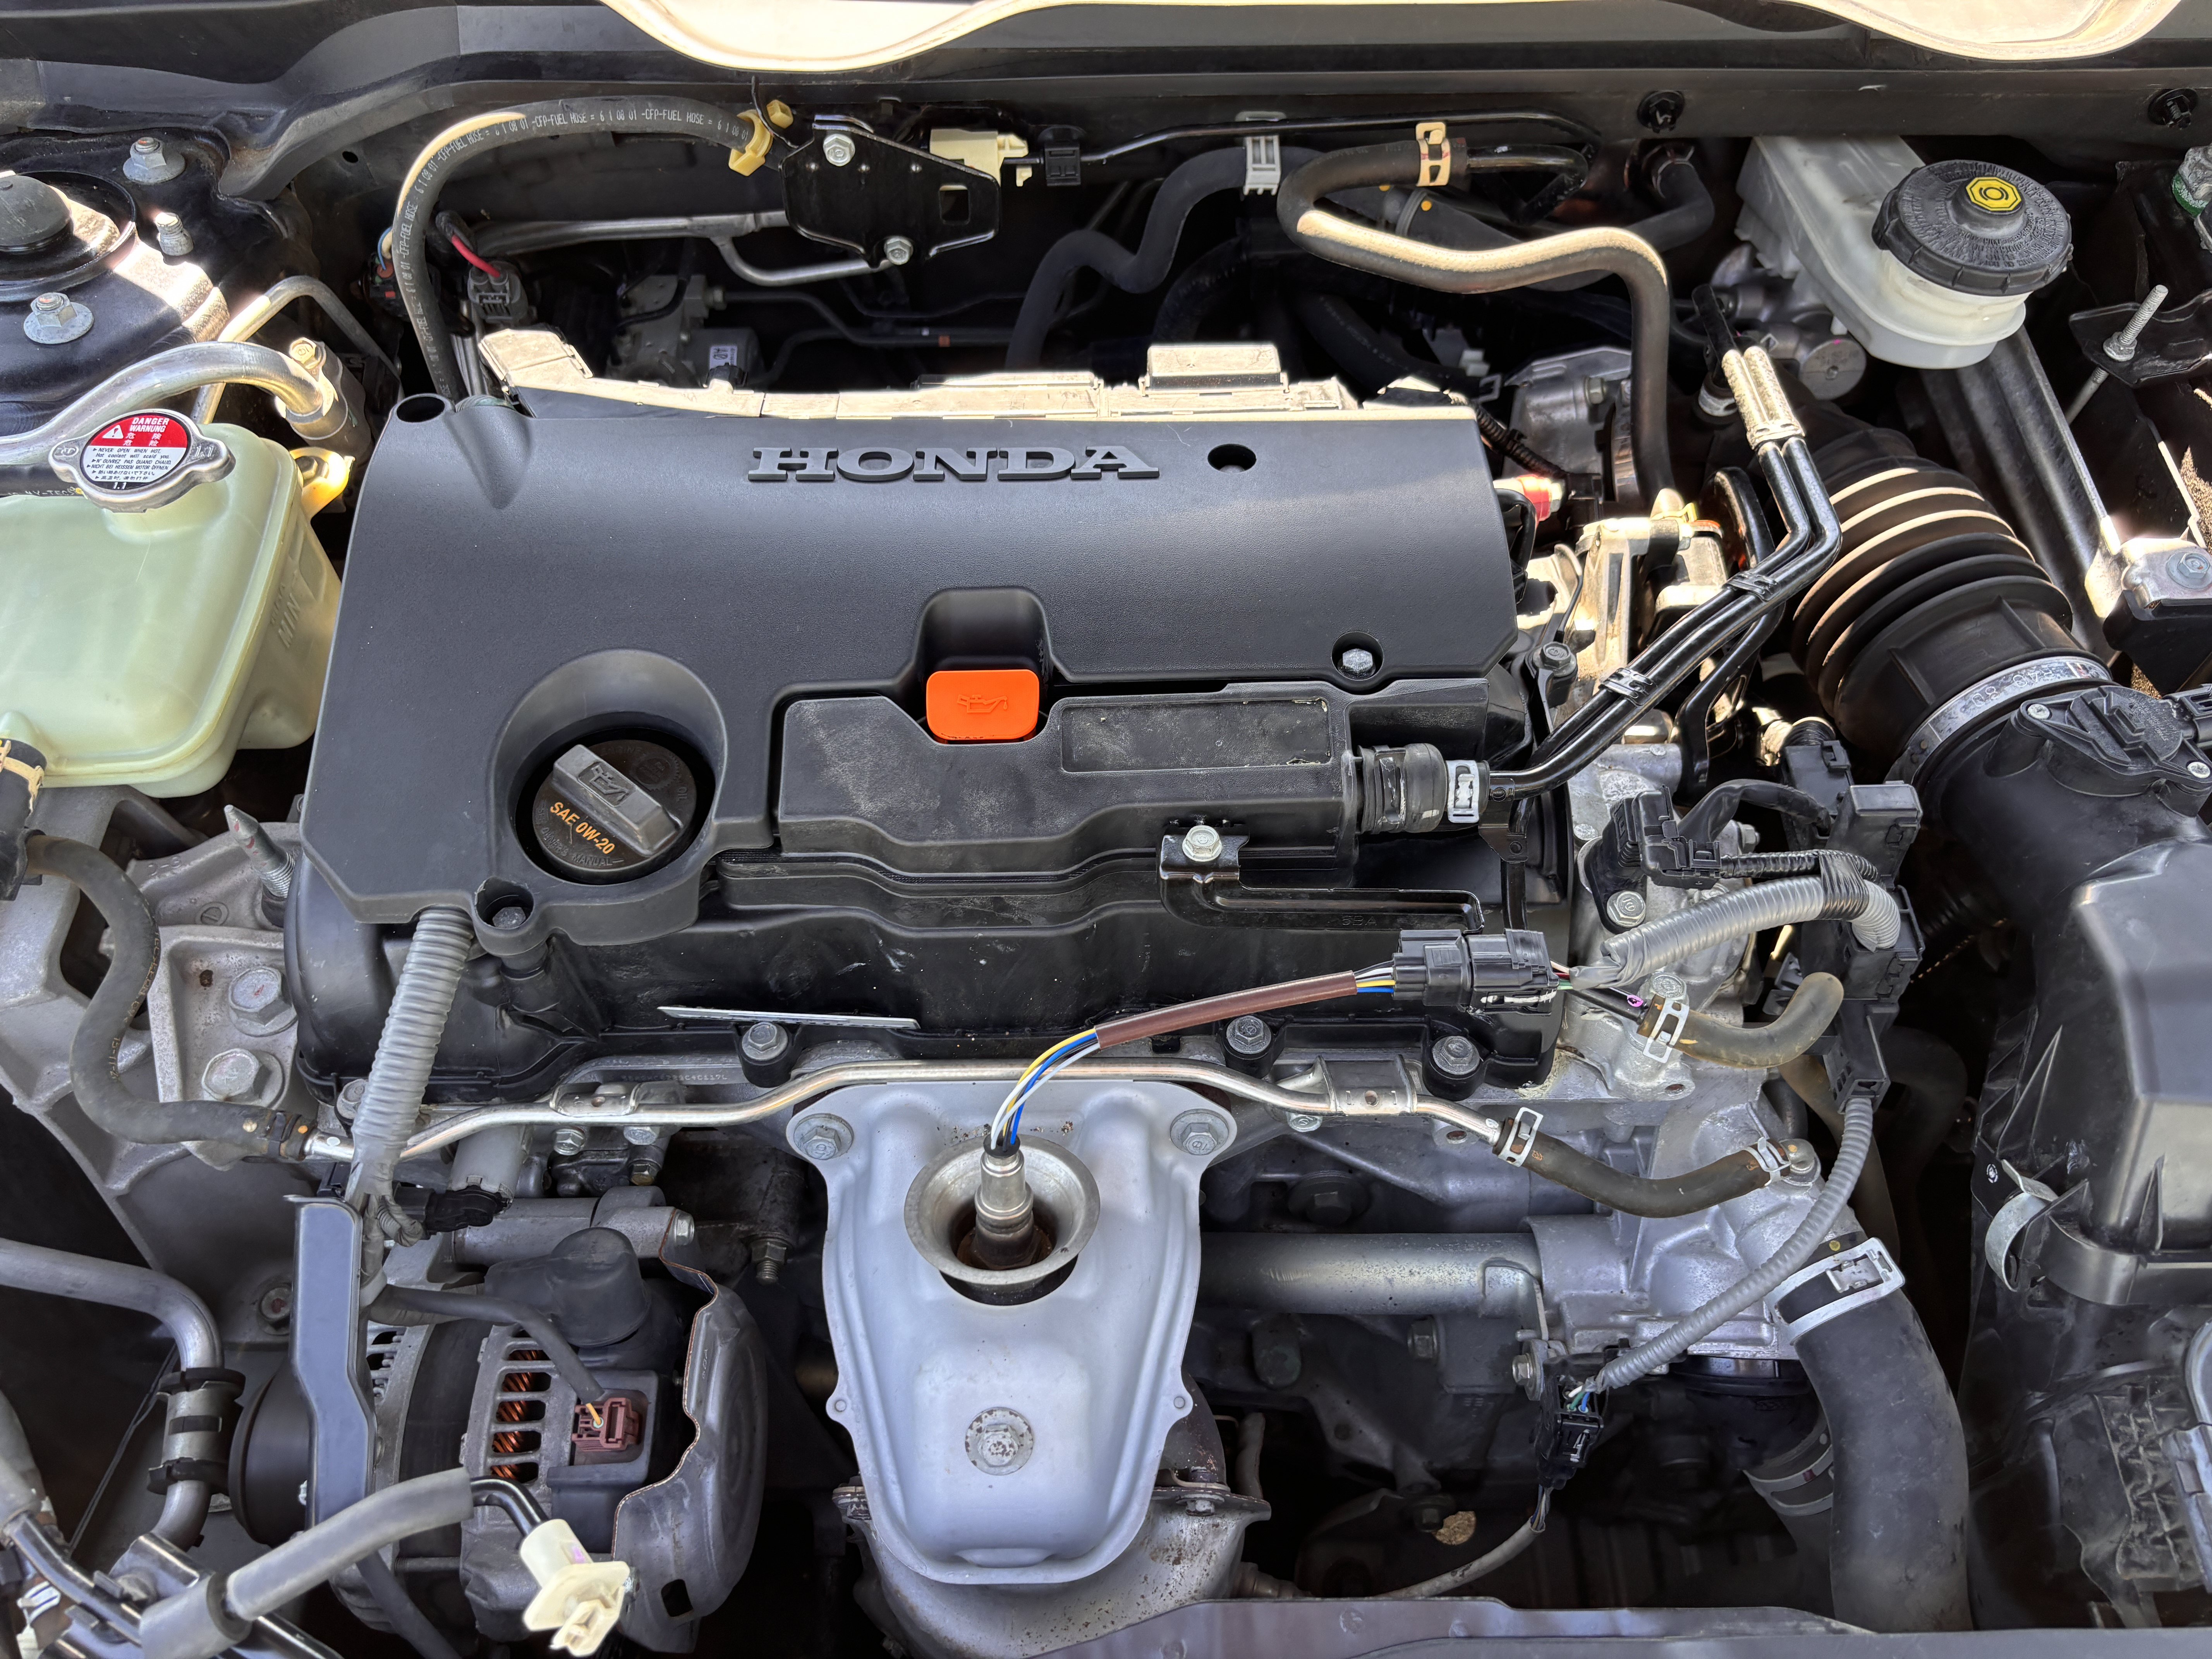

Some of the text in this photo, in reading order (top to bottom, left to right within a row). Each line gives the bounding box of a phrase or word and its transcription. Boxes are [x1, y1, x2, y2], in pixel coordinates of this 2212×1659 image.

[571, 113, 587, 123] HOSE
[600, 110, 605, 121] 6
[617, 110, 625, 120] 08
[629, 110, 637, 120] 01
[687, 112, 704, 125] HOSE
[718, 122, 722, 130] 6
[732, 126, 740, 137] 08
[466, 129, 484, 145] HOSE
[509, 120, 518, 132] 08
[520, 118, 529, 130] 01
[404, 201, 419, 222] HOSE
[428, 160, 439, 172] 01
[747, 445, 1160, 482] HONDA
[278, 592, 301, 648] MIN
[677, 786, 688, 802] OIL
[550, 802, 615, 854] SAE 0W-20
[572, 852, 613, 866] MANUAL
